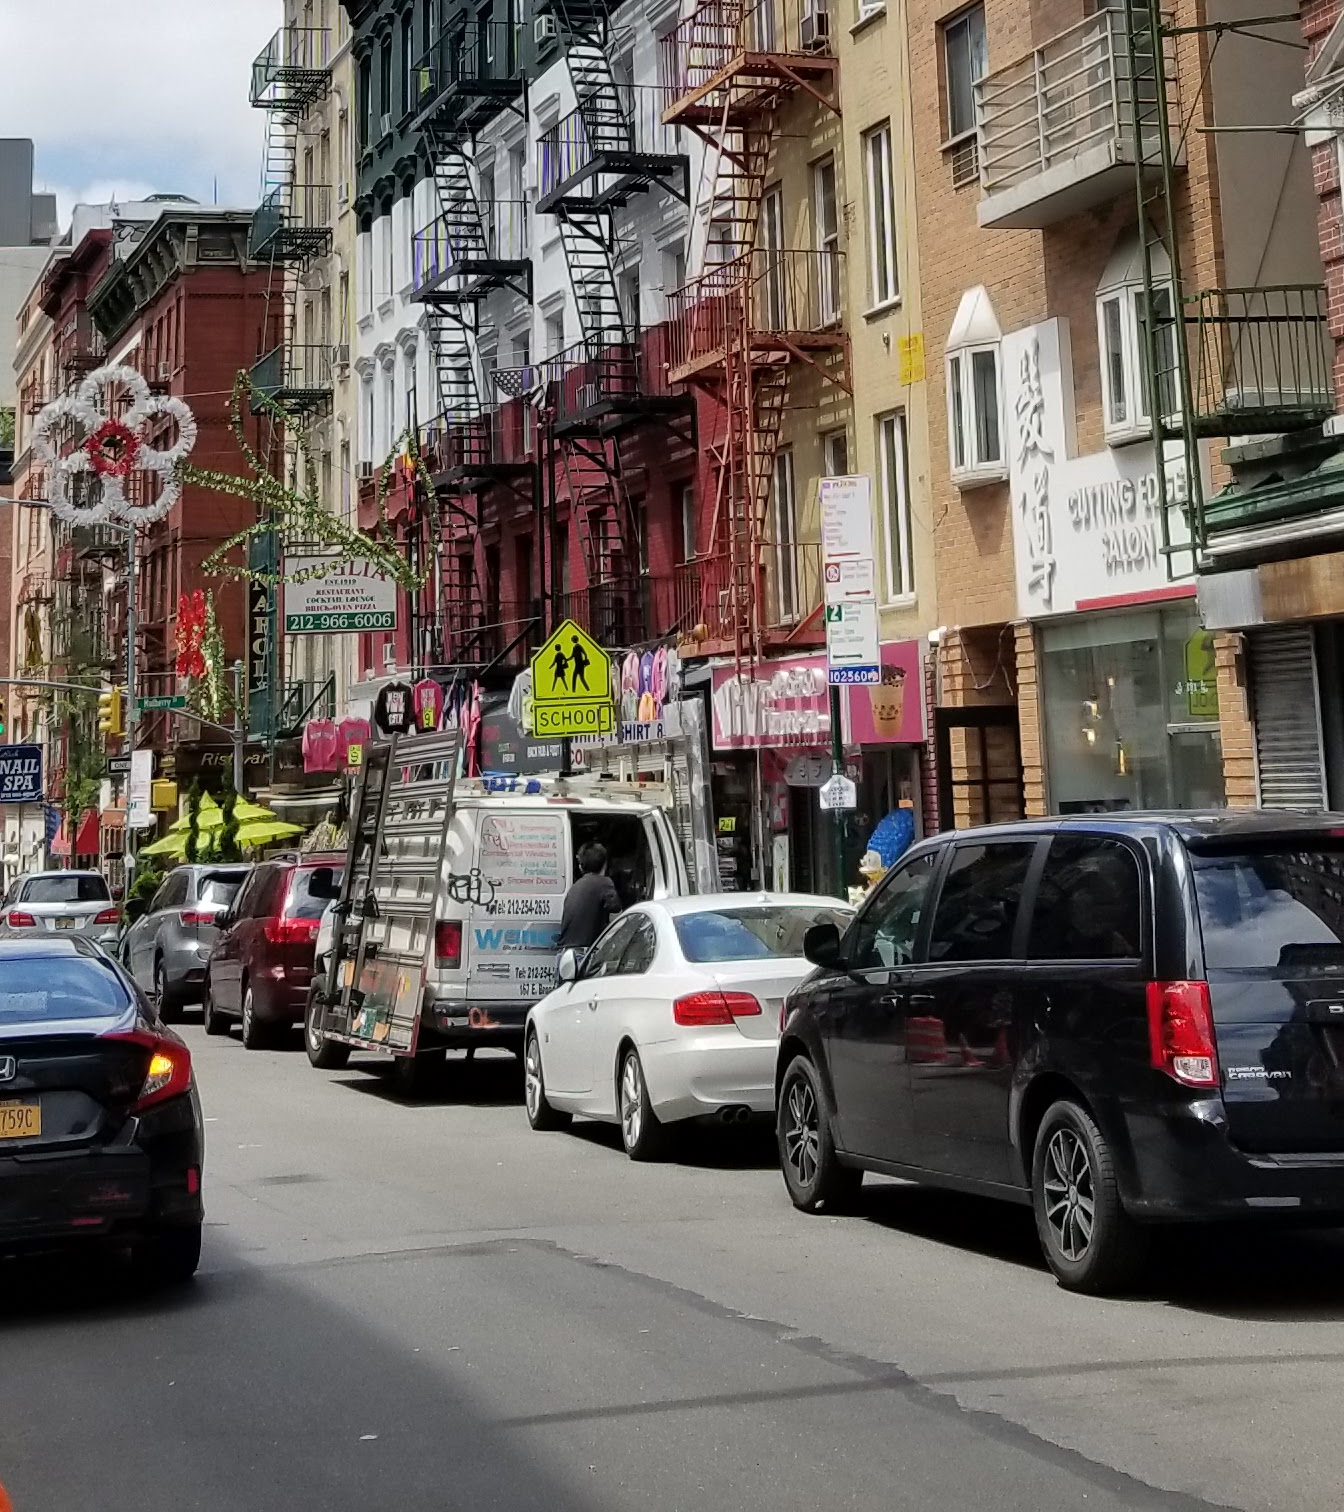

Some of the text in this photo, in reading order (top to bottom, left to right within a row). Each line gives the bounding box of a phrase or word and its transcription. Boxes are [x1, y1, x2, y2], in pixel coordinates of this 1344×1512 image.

[1068, 478, 1136, 530] CUTTING
[1102, 524, 1157, 575] SALON
[290, 612, 392, 630] 212-966-6006
[540, 709, 606, 727] SCHOOL
[114, 761, 128, 769] ONE
[3, 775, 34, 791] SPA
